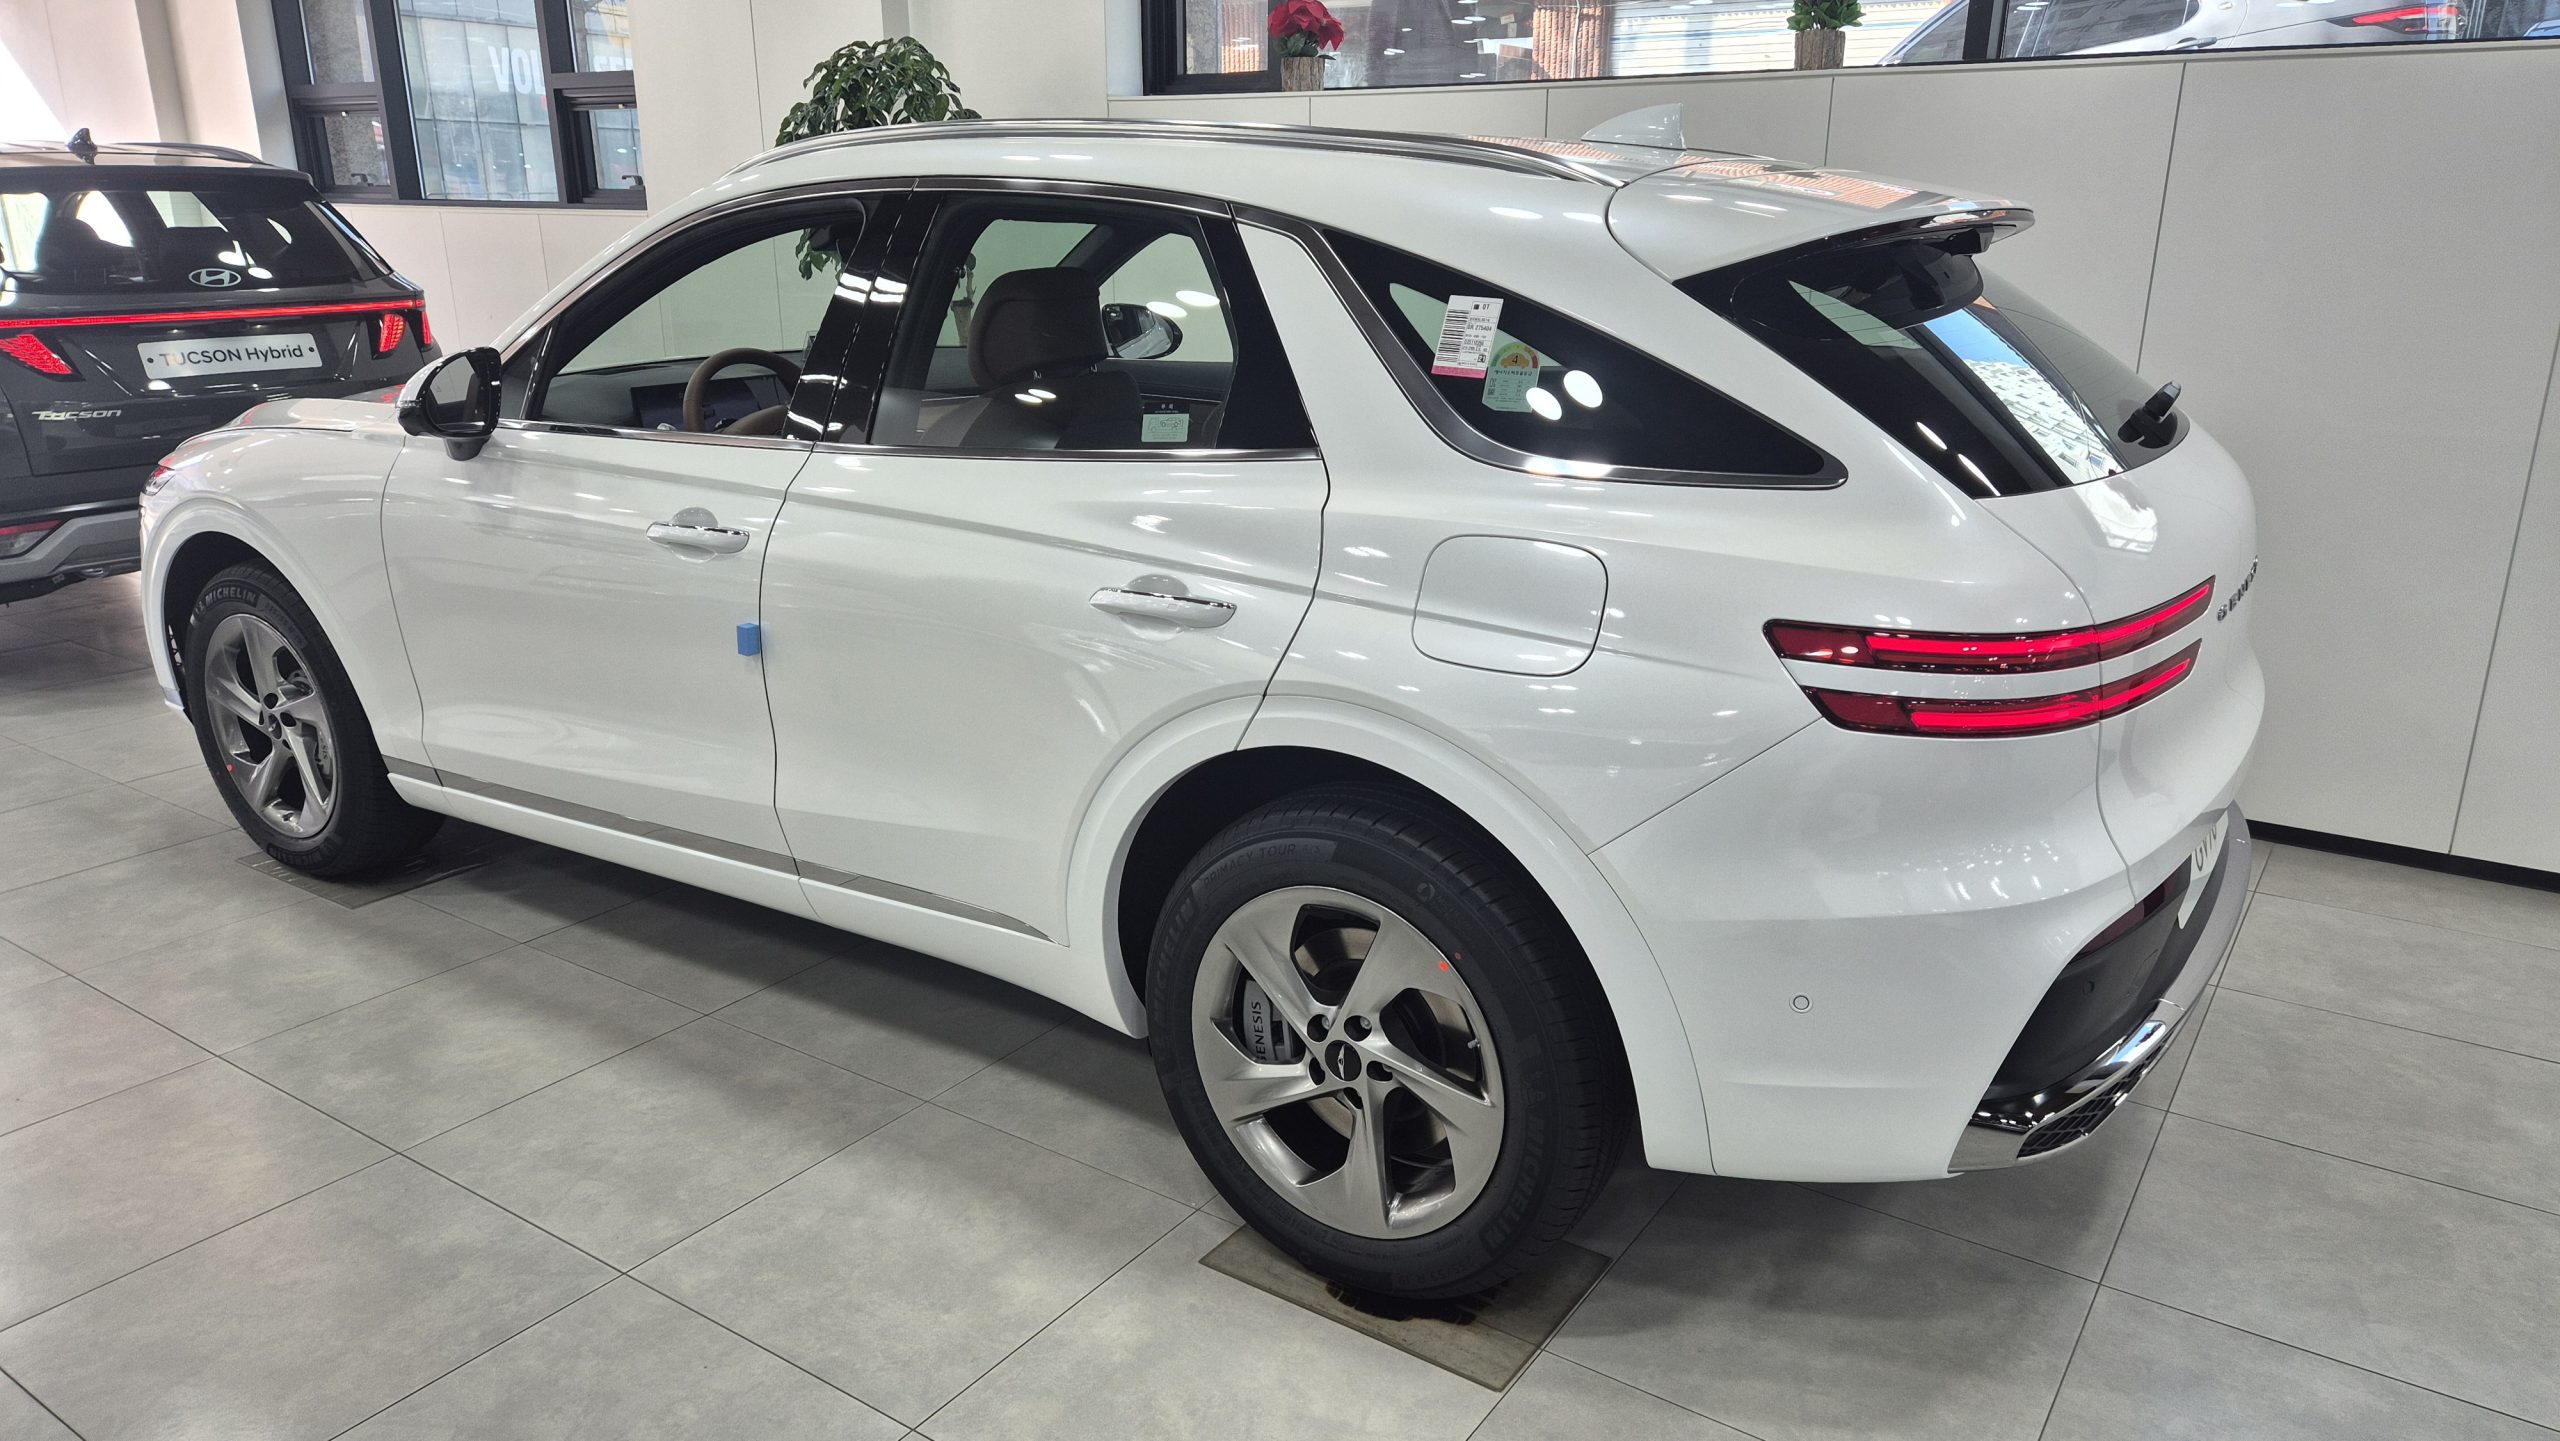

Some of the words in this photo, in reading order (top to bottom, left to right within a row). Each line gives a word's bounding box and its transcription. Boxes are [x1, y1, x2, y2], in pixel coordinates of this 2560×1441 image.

[159, 348, 242, 367] TUCSON
[245, 344, 304, 363] Hybrid
[204, 585, 256, 607] MICHELIN
[1203, 850, 1254, 889] PRIMACY
[1260, 843, 1297, 859] TOUR
